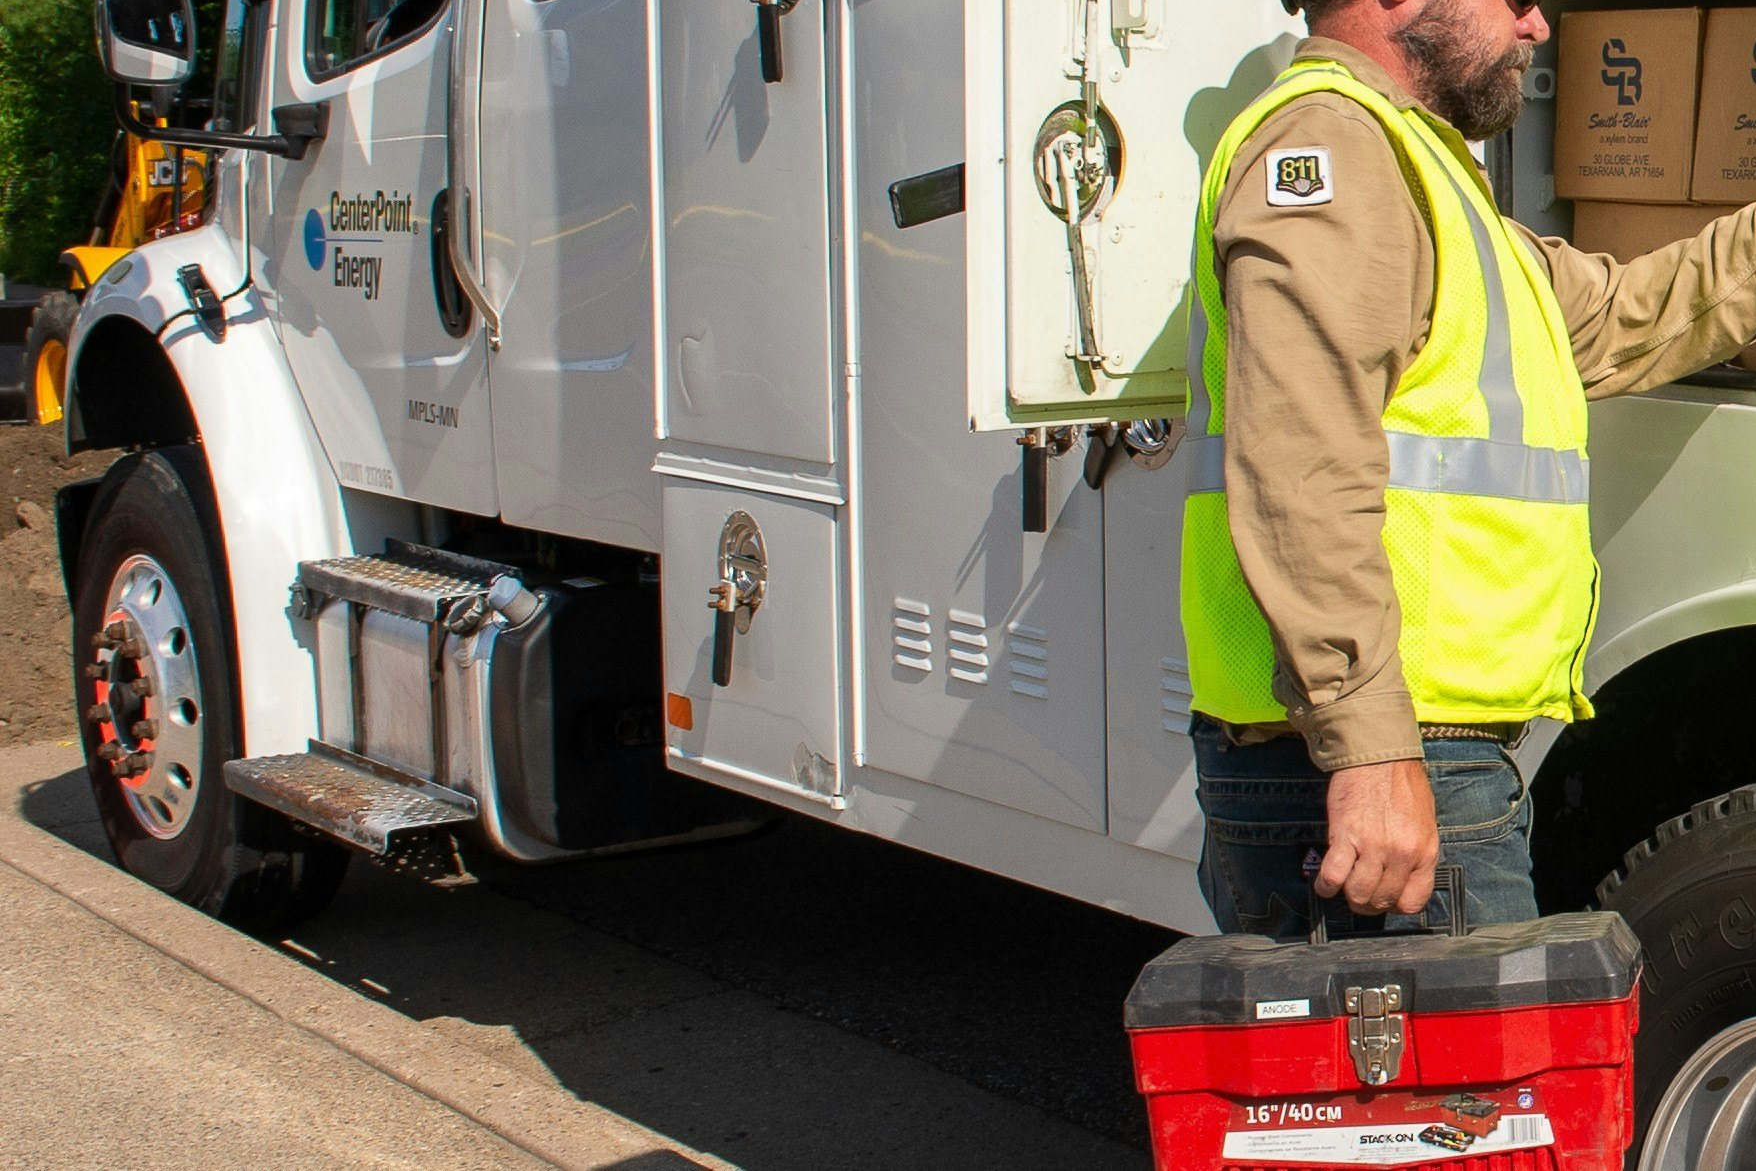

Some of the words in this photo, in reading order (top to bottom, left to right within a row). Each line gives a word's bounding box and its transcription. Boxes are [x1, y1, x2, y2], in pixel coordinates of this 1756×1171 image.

[1627, 133, 1649, 144] brand
[1593, 153, 1603, 165] 30
[1603, 153, 1632, 166] GLOBE
[1633, 154, 1650, 166] AVE
[1279, 155, 1319, 183] 811
[1629, 167, 1641, 177] AR
[334, 246, 382, 301] Energy
[408, 399, 460, 429] MPLS-MN
[1262, 1003, 1297, 1015] ANODE
